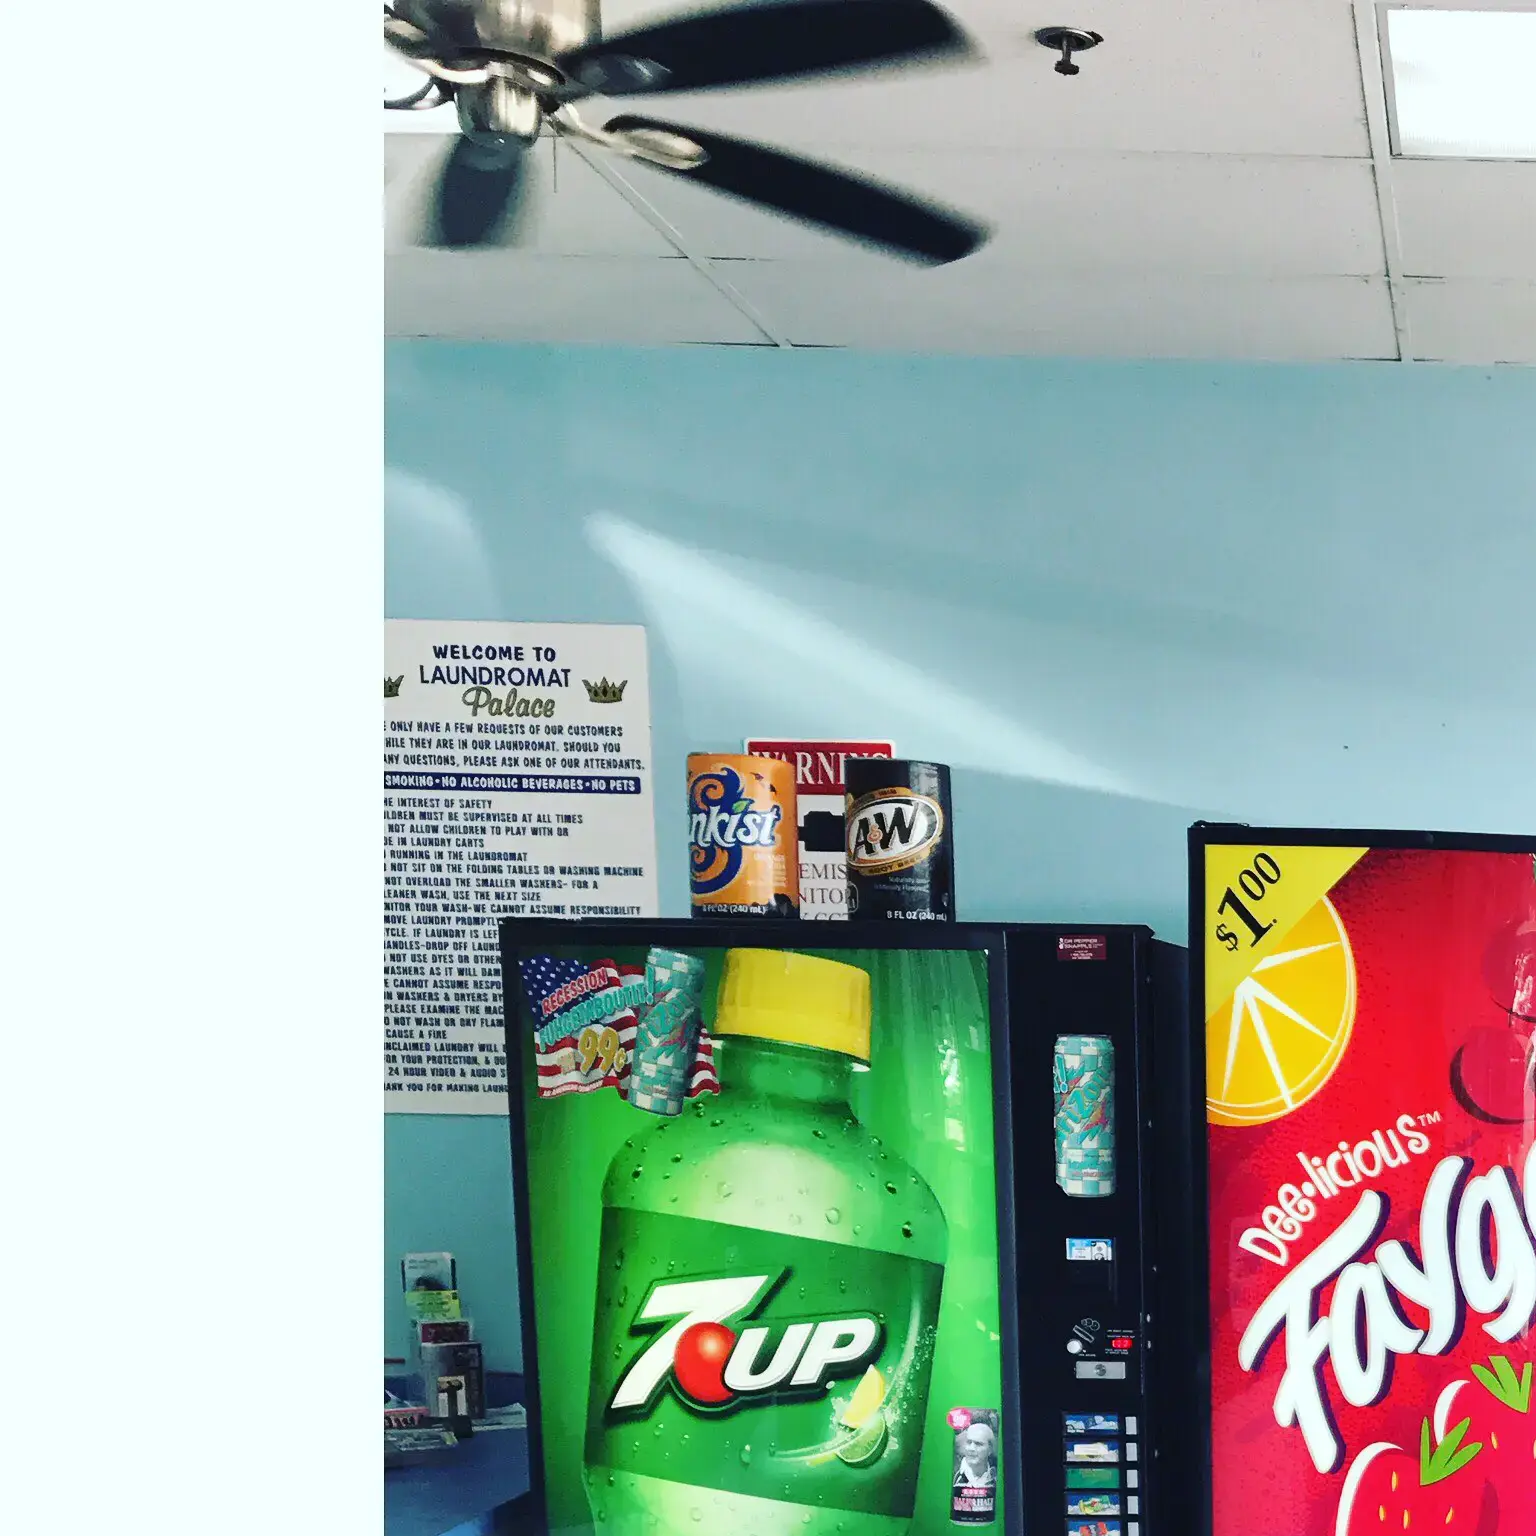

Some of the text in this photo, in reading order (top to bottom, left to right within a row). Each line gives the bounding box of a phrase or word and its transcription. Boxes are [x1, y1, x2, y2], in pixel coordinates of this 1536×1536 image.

[432, 644, 556, 663] WELCOME TO
[418, 664, 572, 688] LAUNDROMAT
[461, 685, 556, 718] Palace
[390, 721, 622, 736] ONLY HAVE FEW REQUESTS OUR CUSTOMERS
[410, 737, 620, 752] THEY ARE OUR LAUNDROMAT. SHOULD YOU
[403, 754, 644, 769] QUESTIONS, PLEASE ASK ONE OUR ATTENDANTS.
[541, 966, 609, 1017] RECESSION
